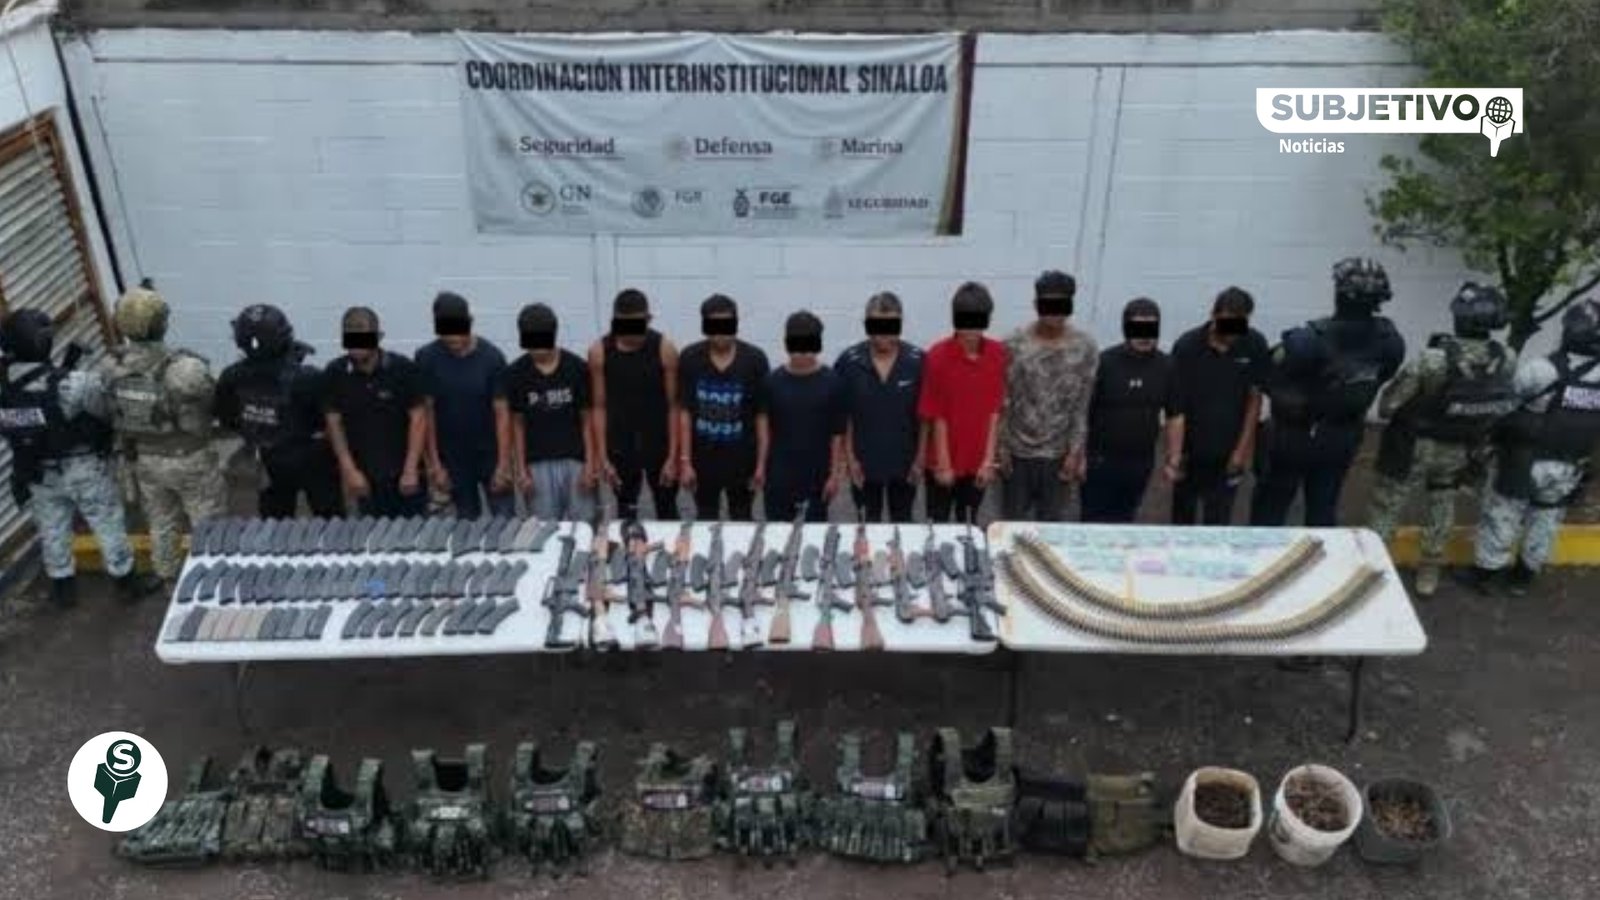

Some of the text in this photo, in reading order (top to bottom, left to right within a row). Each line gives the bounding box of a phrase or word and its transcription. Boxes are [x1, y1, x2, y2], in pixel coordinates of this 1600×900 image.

[466, 58, 948, 94] COORDINACIÓN INTERINSTITUCIONAL SINALOA
[518, 135, 616, 157] Seguridad
[694, 137, 774, 154] Defensa
[841, 138, 904, 154] Marina
[759, 191, 792, 205] FGE
